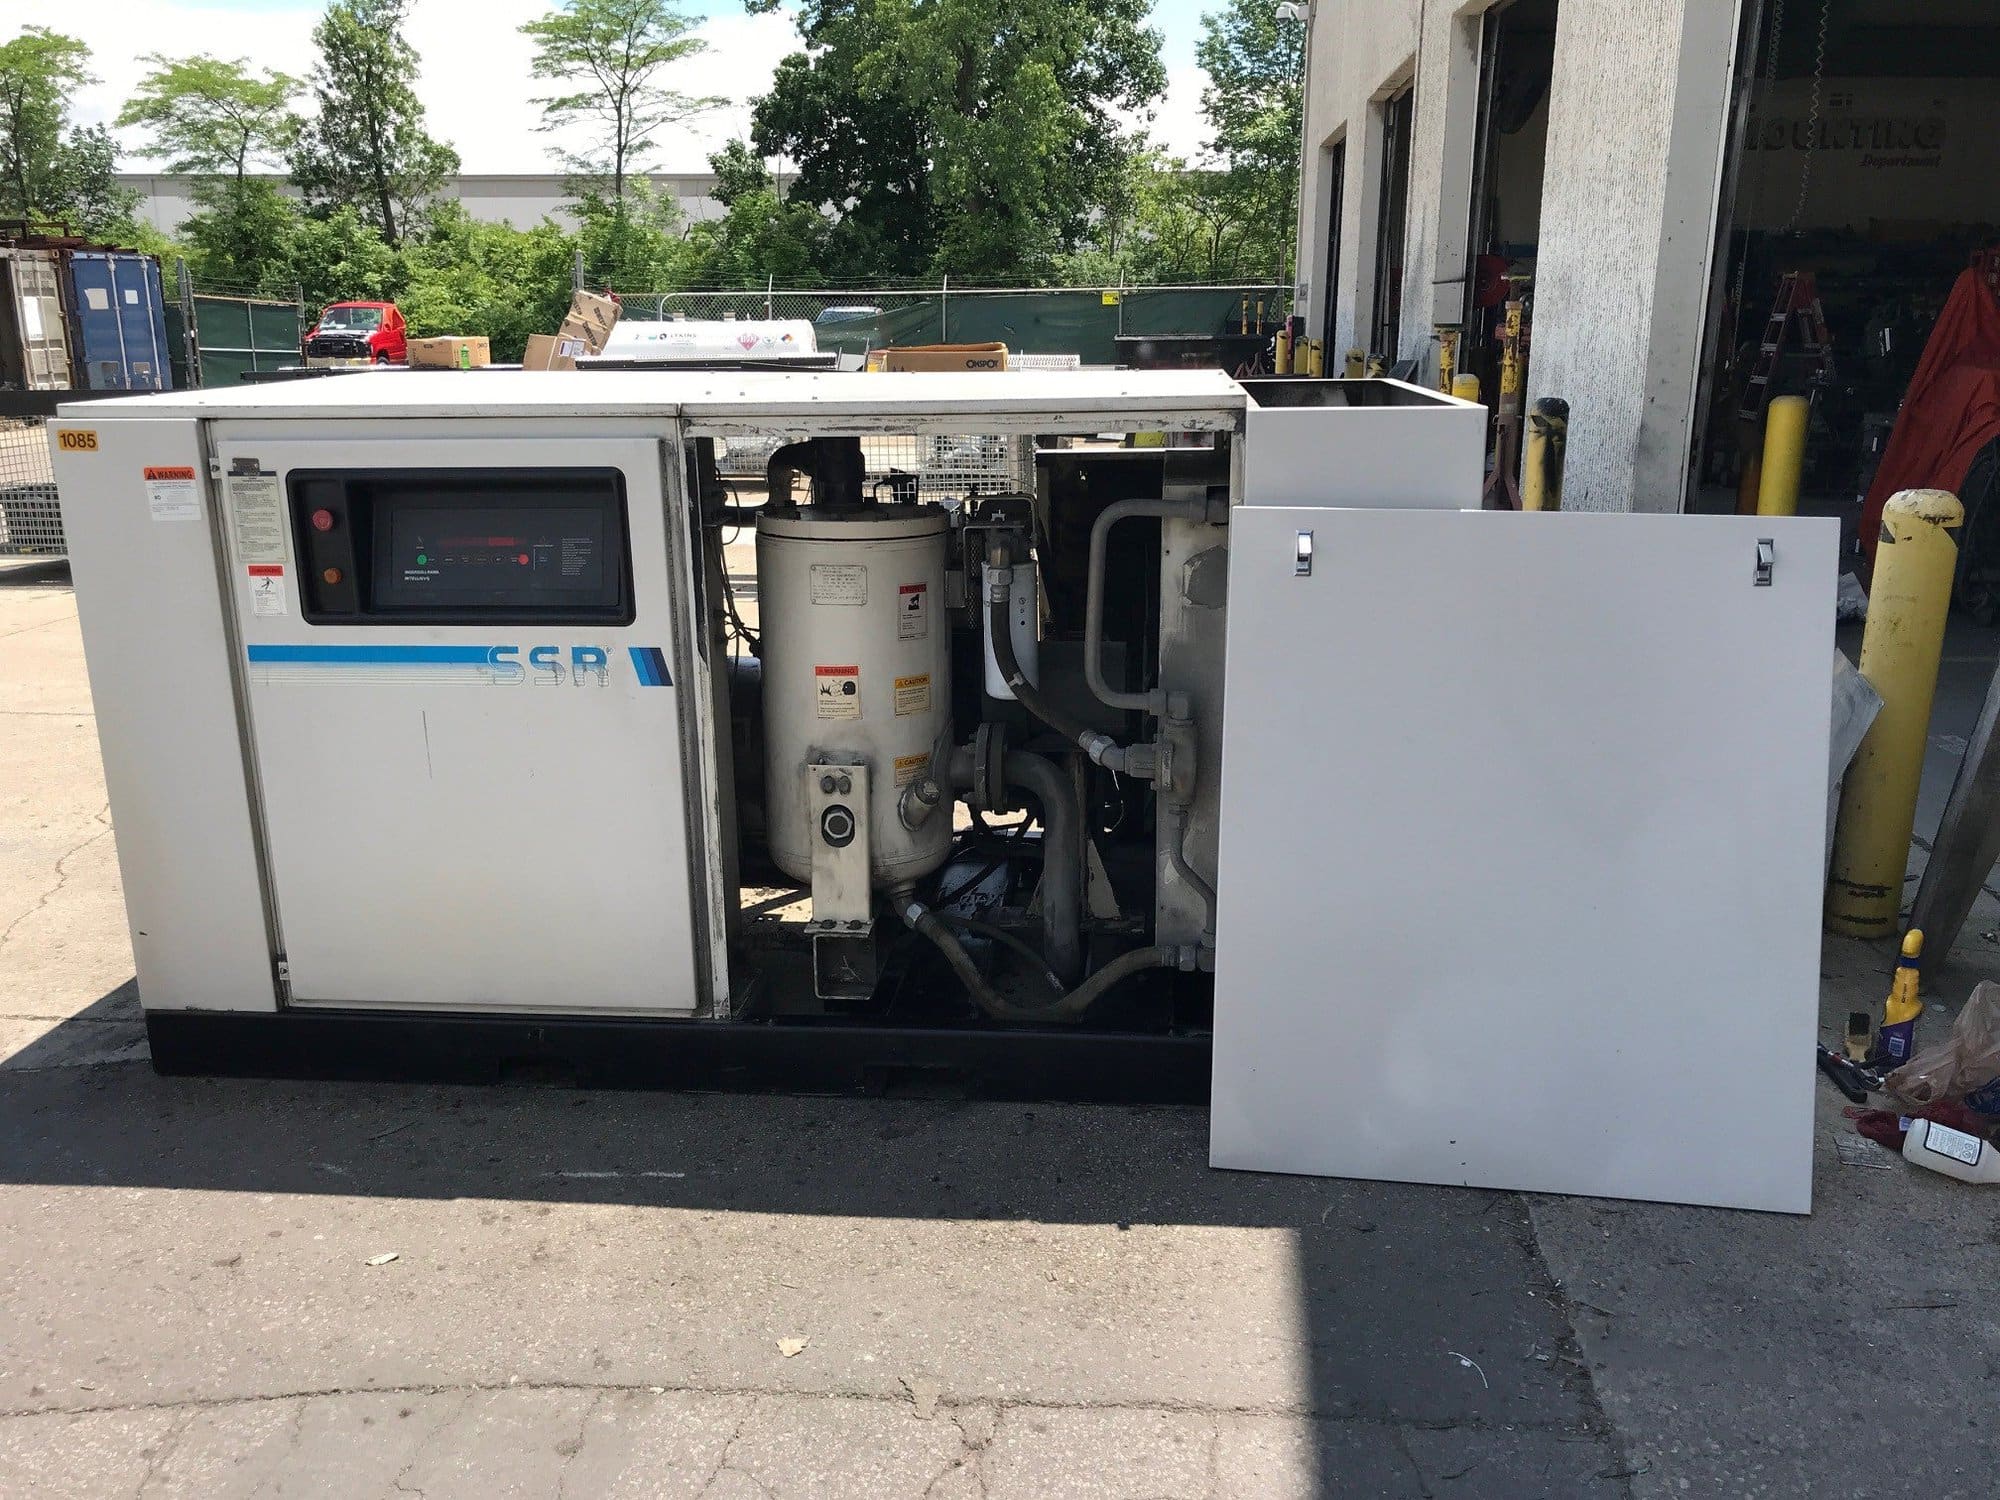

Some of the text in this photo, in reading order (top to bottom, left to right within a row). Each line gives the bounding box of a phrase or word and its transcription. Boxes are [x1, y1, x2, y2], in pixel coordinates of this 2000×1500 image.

[60, 433, 96, 448] 1085
[157, 470, 192, 480] WARNING
[488, 646, 609, 687] SSR
[904, 676, 928, 686] CAUTION
[904, 756, 928, 766] CAUTION
